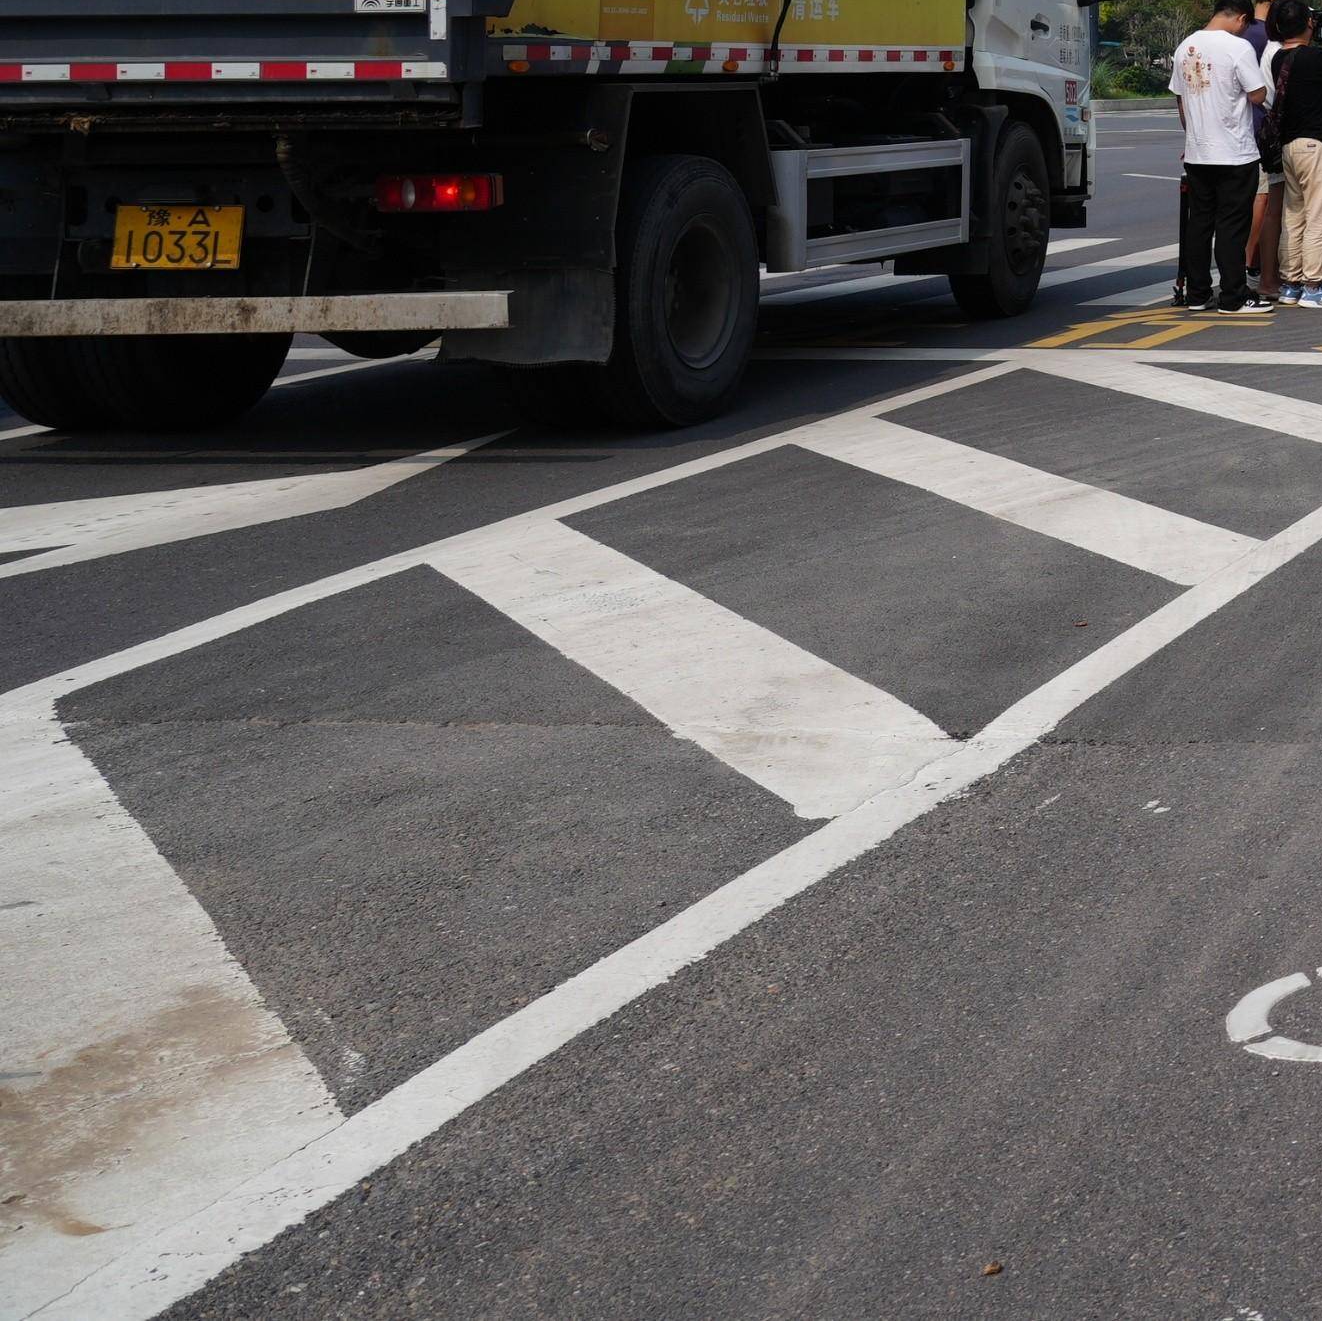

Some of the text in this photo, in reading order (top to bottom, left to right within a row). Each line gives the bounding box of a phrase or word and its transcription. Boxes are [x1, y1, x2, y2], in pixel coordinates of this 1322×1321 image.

[716, 11, 769, 23] Residual Waste
[125, 230, 231, 265] 1033L
